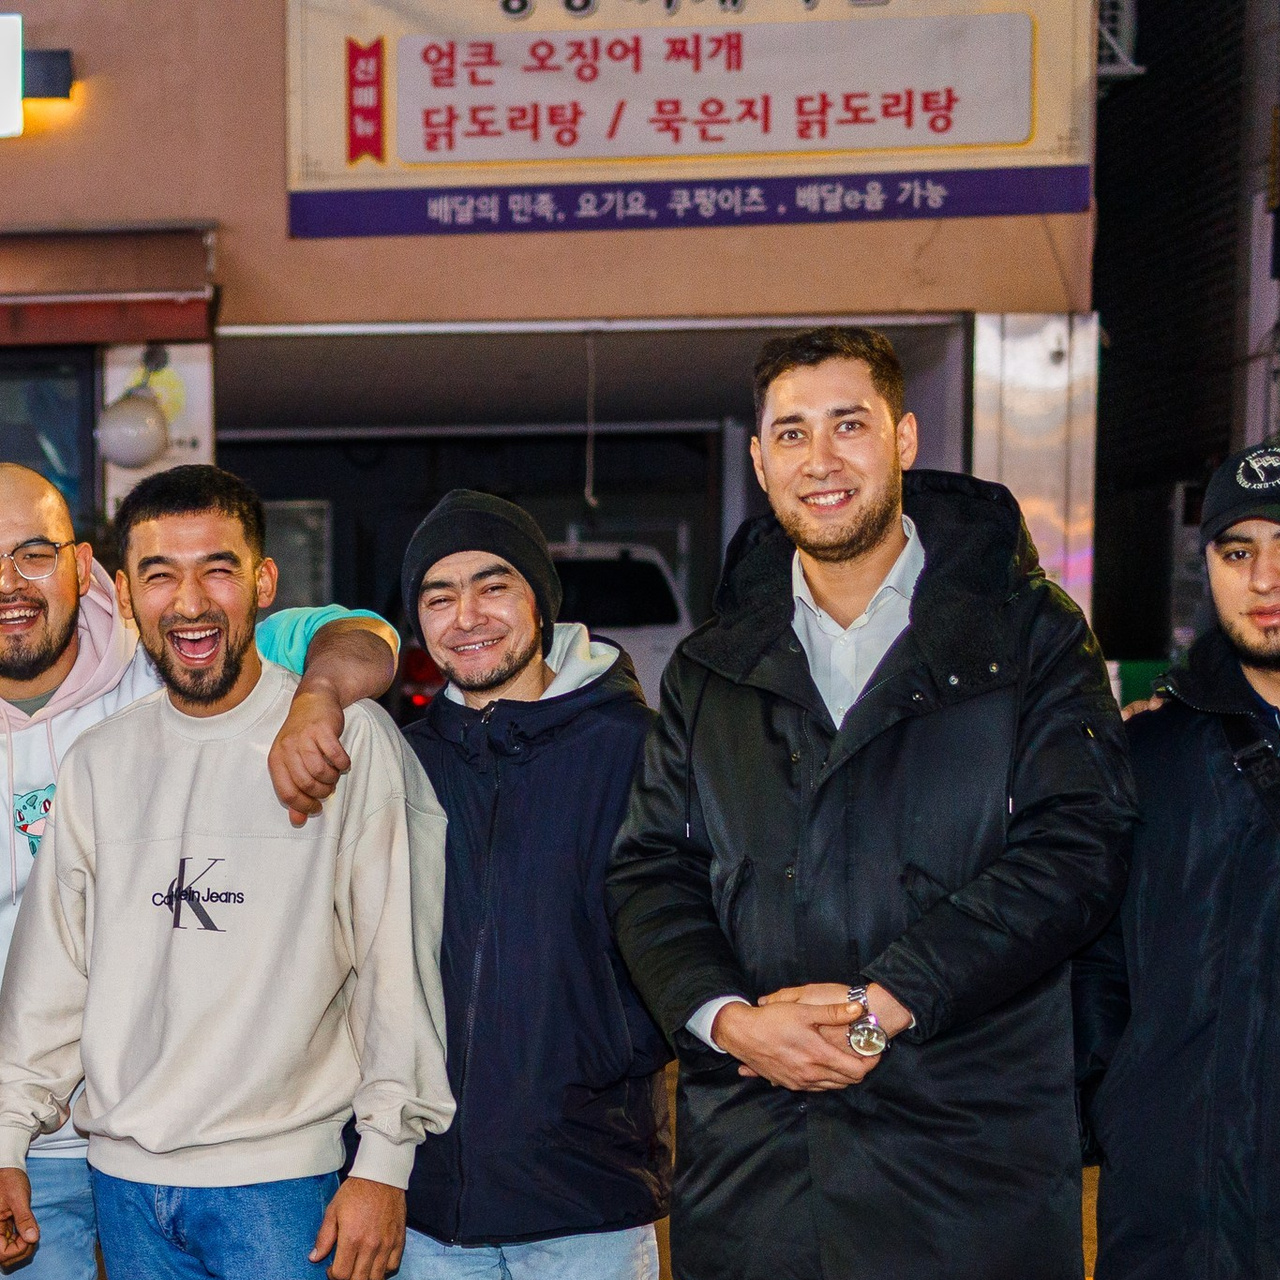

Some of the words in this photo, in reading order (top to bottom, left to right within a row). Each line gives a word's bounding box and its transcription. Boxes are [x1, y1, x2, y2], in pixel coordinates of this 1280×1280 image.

[421, 40, 502, 88] 얼큰
[521, 34, 642, 83] 오징어
[664, 32, 744, 73] 찌개
[422, 100, 585, 153] 닭도리탕
[649, 93, 773, 144] 묵은지
[795, 87, 959, 140] 닭도리탕
[426, 194, 500, 225] 배달의
[896, 178, 948, 210] 가능
[201, 887, 245, 904] Jeans
